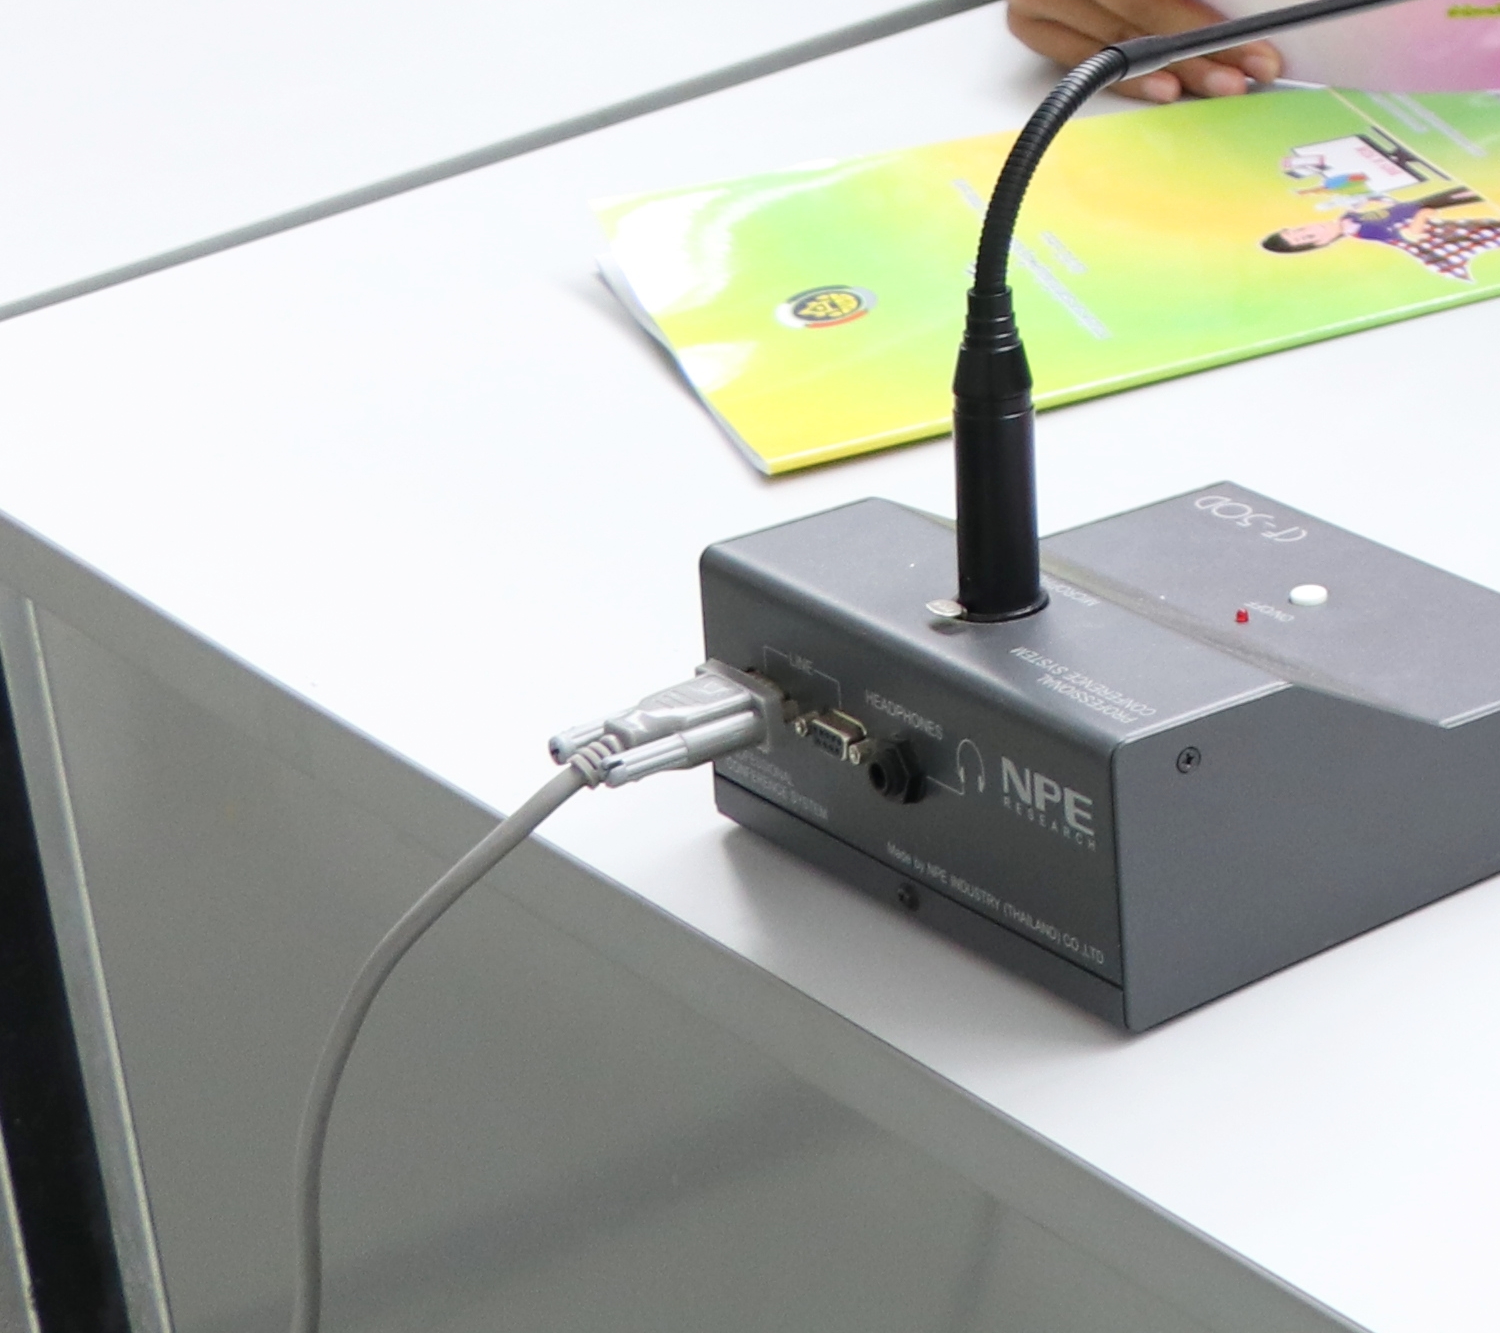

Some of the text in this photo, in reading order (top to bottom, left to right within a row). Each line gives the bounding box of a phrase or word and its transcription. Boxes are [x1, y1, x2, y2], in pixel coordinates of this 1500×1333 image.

[789, 652, 813, 675] LINE
[1010, 646, 1157, 718] CONFERENCE SYSTEM
[865, 689, 943, 741] HEADPHONES
[1037, 673, 1139, 724] PROFESSIONAL
[1001, 756, 1095, 836] NPE
[1003, 796, 1097, 852] RESEARCH
[926, 862, 948, 884] NPE
[950, 875, 1001, 913] INDUSTRY
[1003, 903, 1062, 945] (THAILAND)
